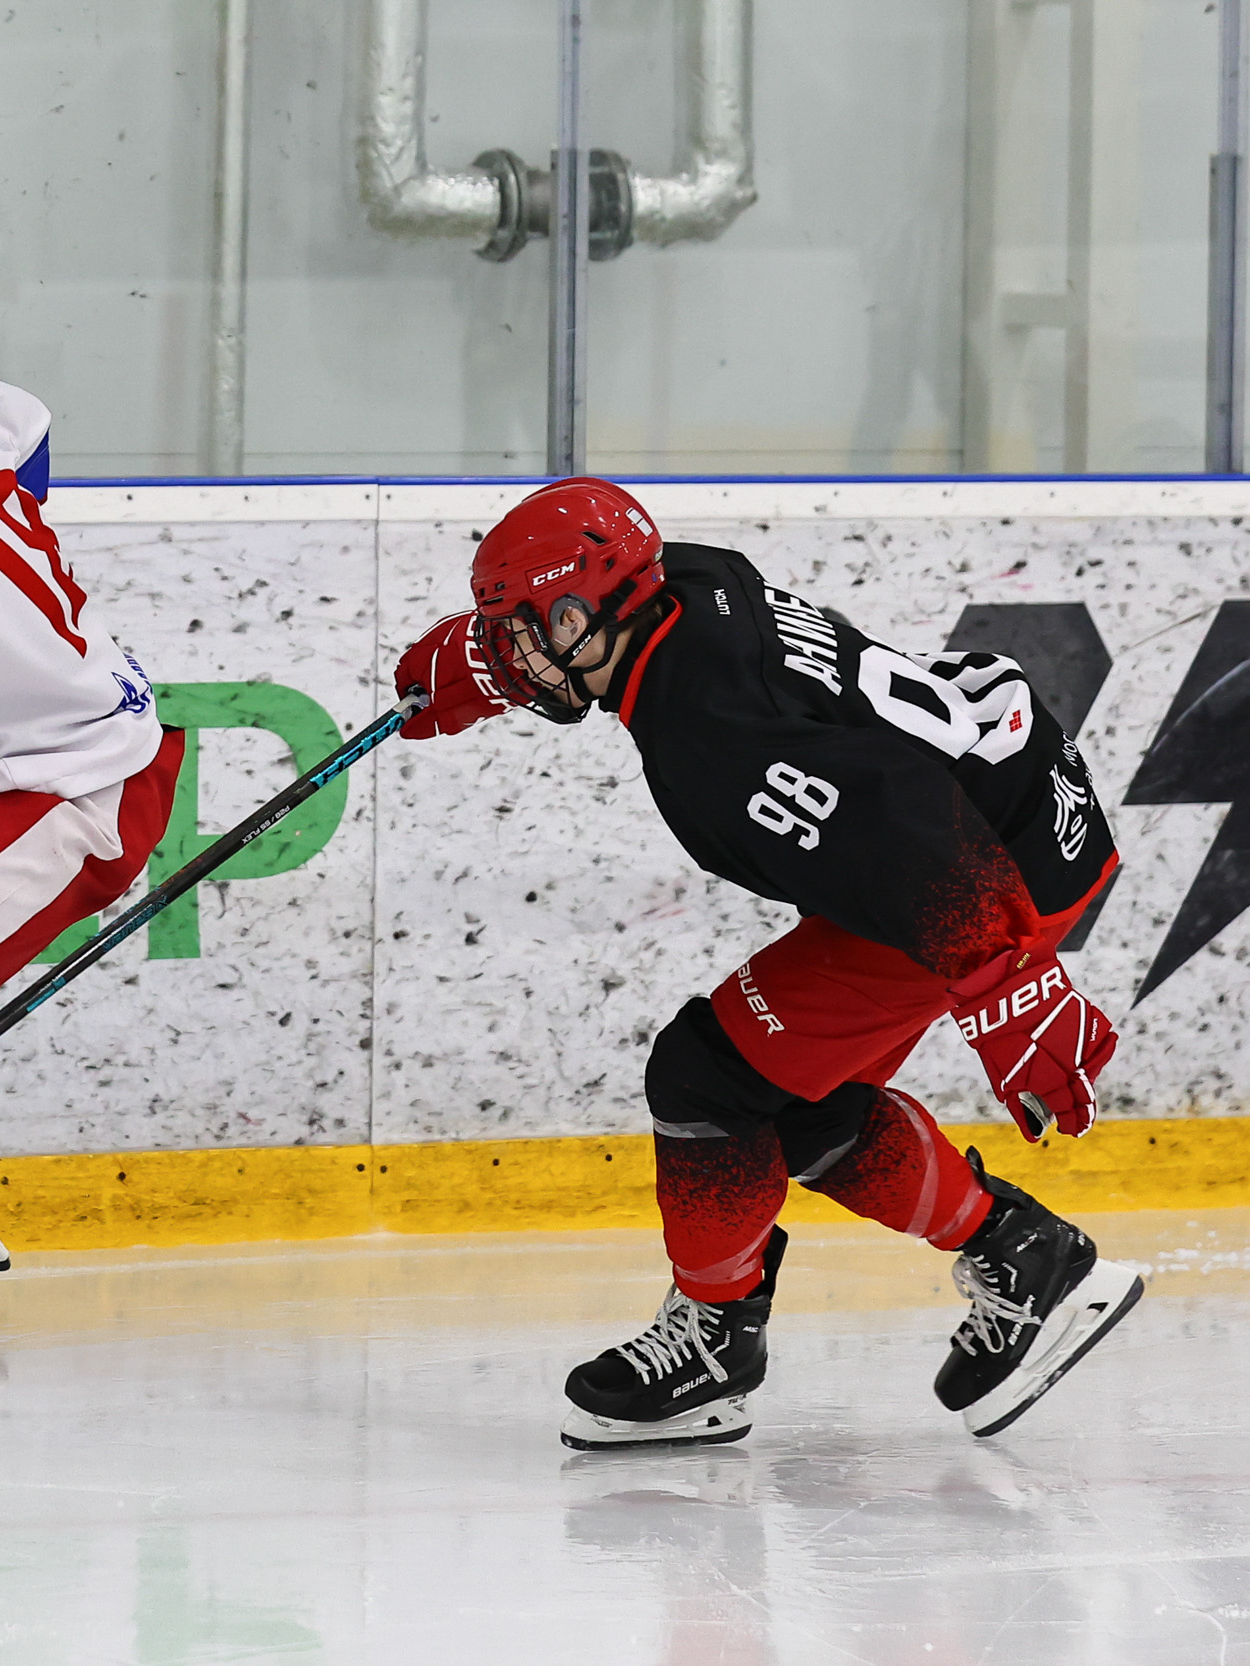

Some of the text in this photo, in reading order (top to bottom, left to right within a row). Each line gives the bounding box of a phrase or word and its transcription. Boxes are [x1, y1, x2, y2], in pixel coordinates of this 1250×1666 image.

[532, 562, 575, 587] CCM
[713, 588, 731, 616] LUTCH
[572, 634, 592, 657] CCM
[747, 761, 840, 851] 98
[240, 826, 261, 844] FLEX
[737, 963, 785, 1037] AUER
[958, 965, 1067, 1042] AUER
